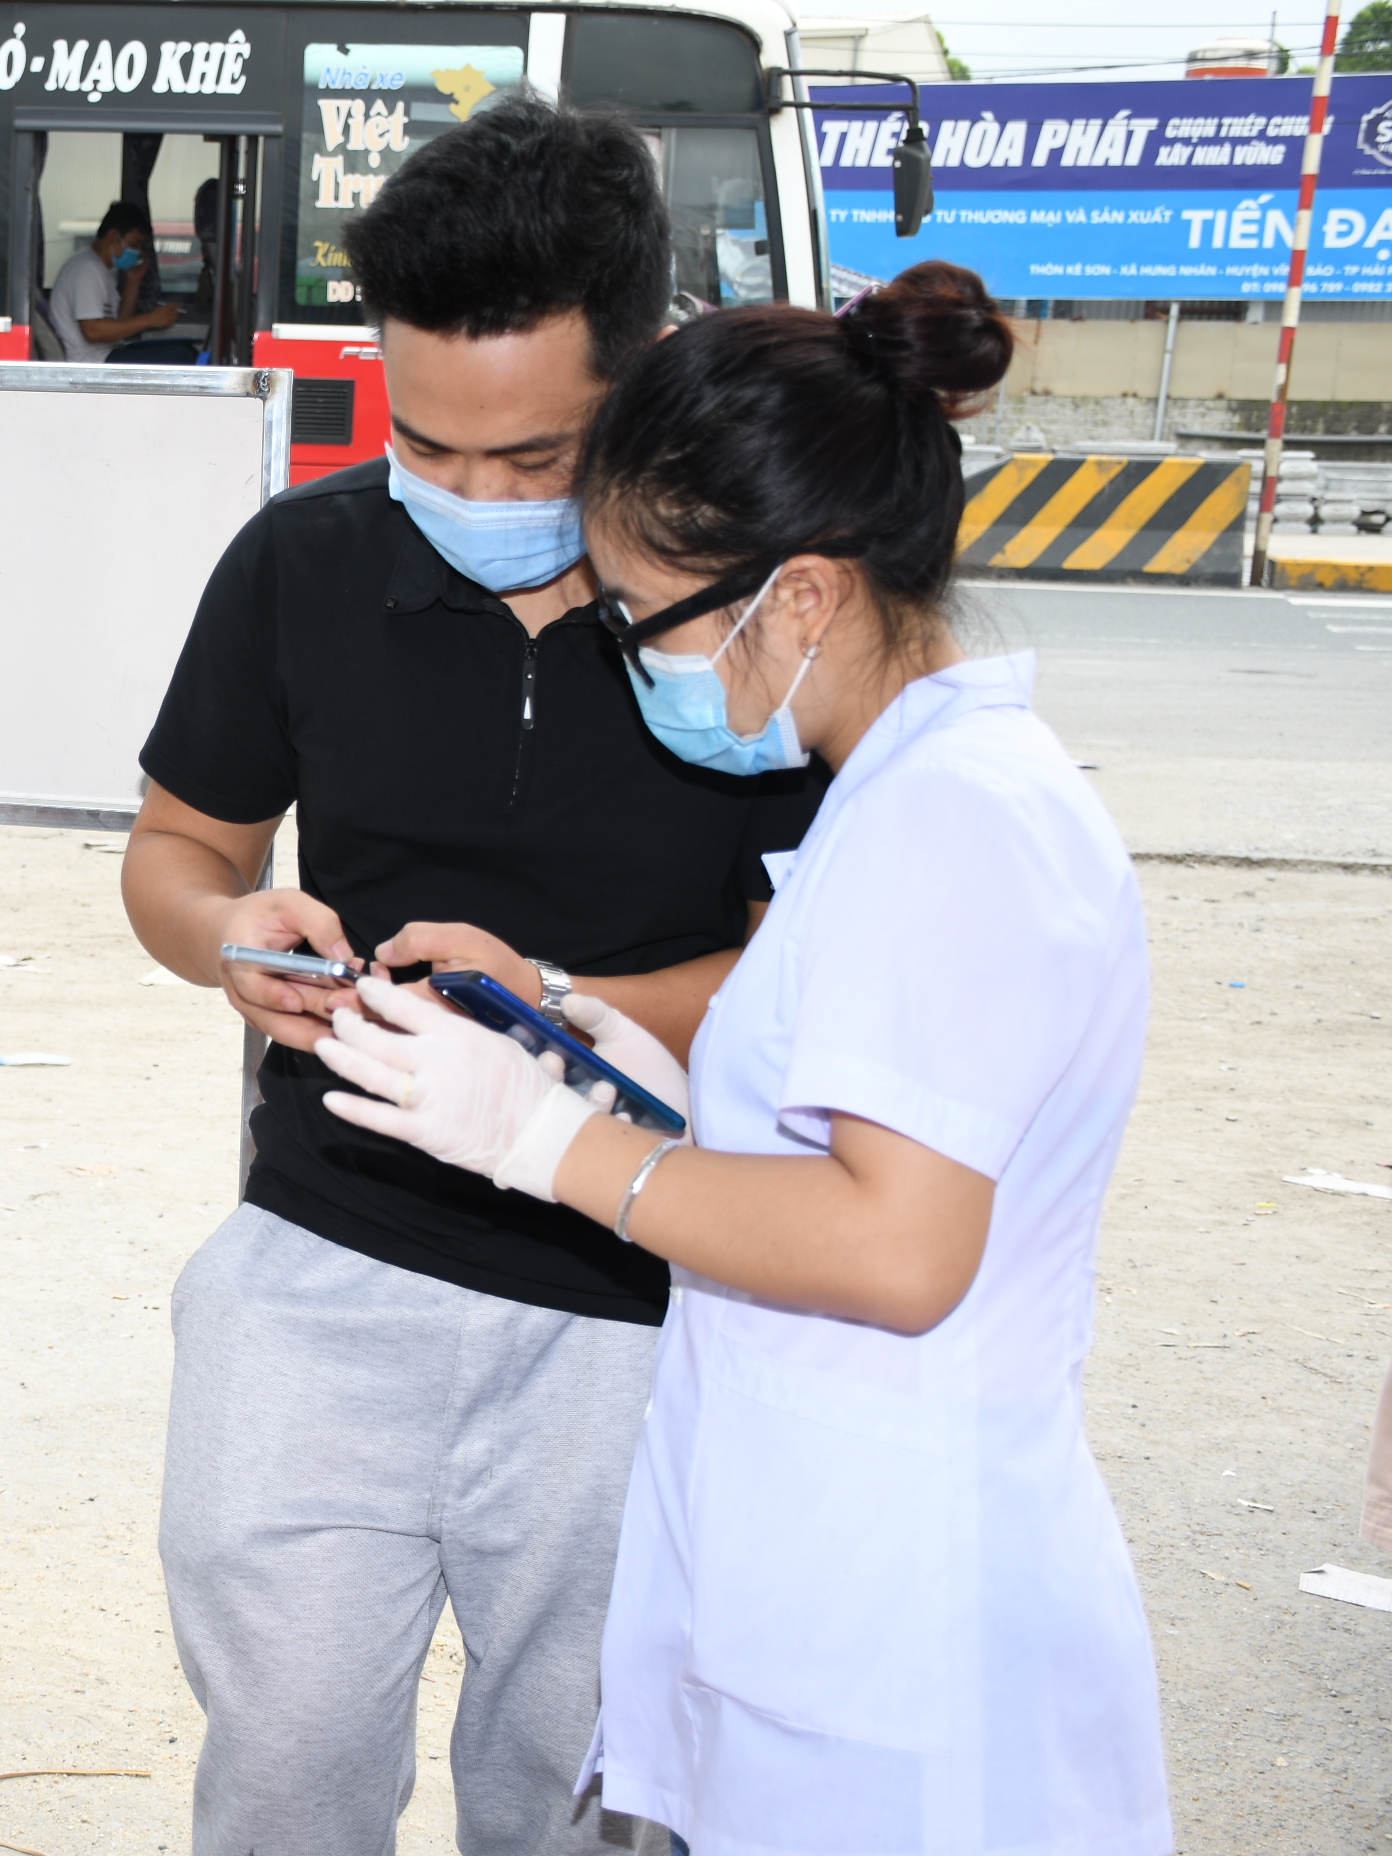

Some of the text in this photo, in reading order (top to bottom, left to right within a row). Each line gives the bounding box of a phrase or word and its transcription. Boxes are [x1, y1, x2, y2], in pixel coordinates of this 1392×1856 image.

[45, 38, 148, 103] MẠO
[152, 29, 251, 94] KHÊ
[318, 66, 406, 89] Nhà xe
[317, 98, 410, 168] Việt
[932, 110, 1027, 168] HÒA
[1031, 109, 1160, 167] PHÁT
[1165, 116, 1219, 143] CHỌN
[1219, 113, 1267, 137] THÉP
[1155, 139, 1286, 166] XÂY NHÀ VỮNG
[829, 208, 849, 223] TY
[960, 207, 1027, 224] THƯƠNG
[1030, 209, 1060, 227] MẠI
[1065, 206, 1088, 224] VÀ
[1127, 204, 1174, 224] XUẤT
[1181, 193, 1296, 249] TIẾN
